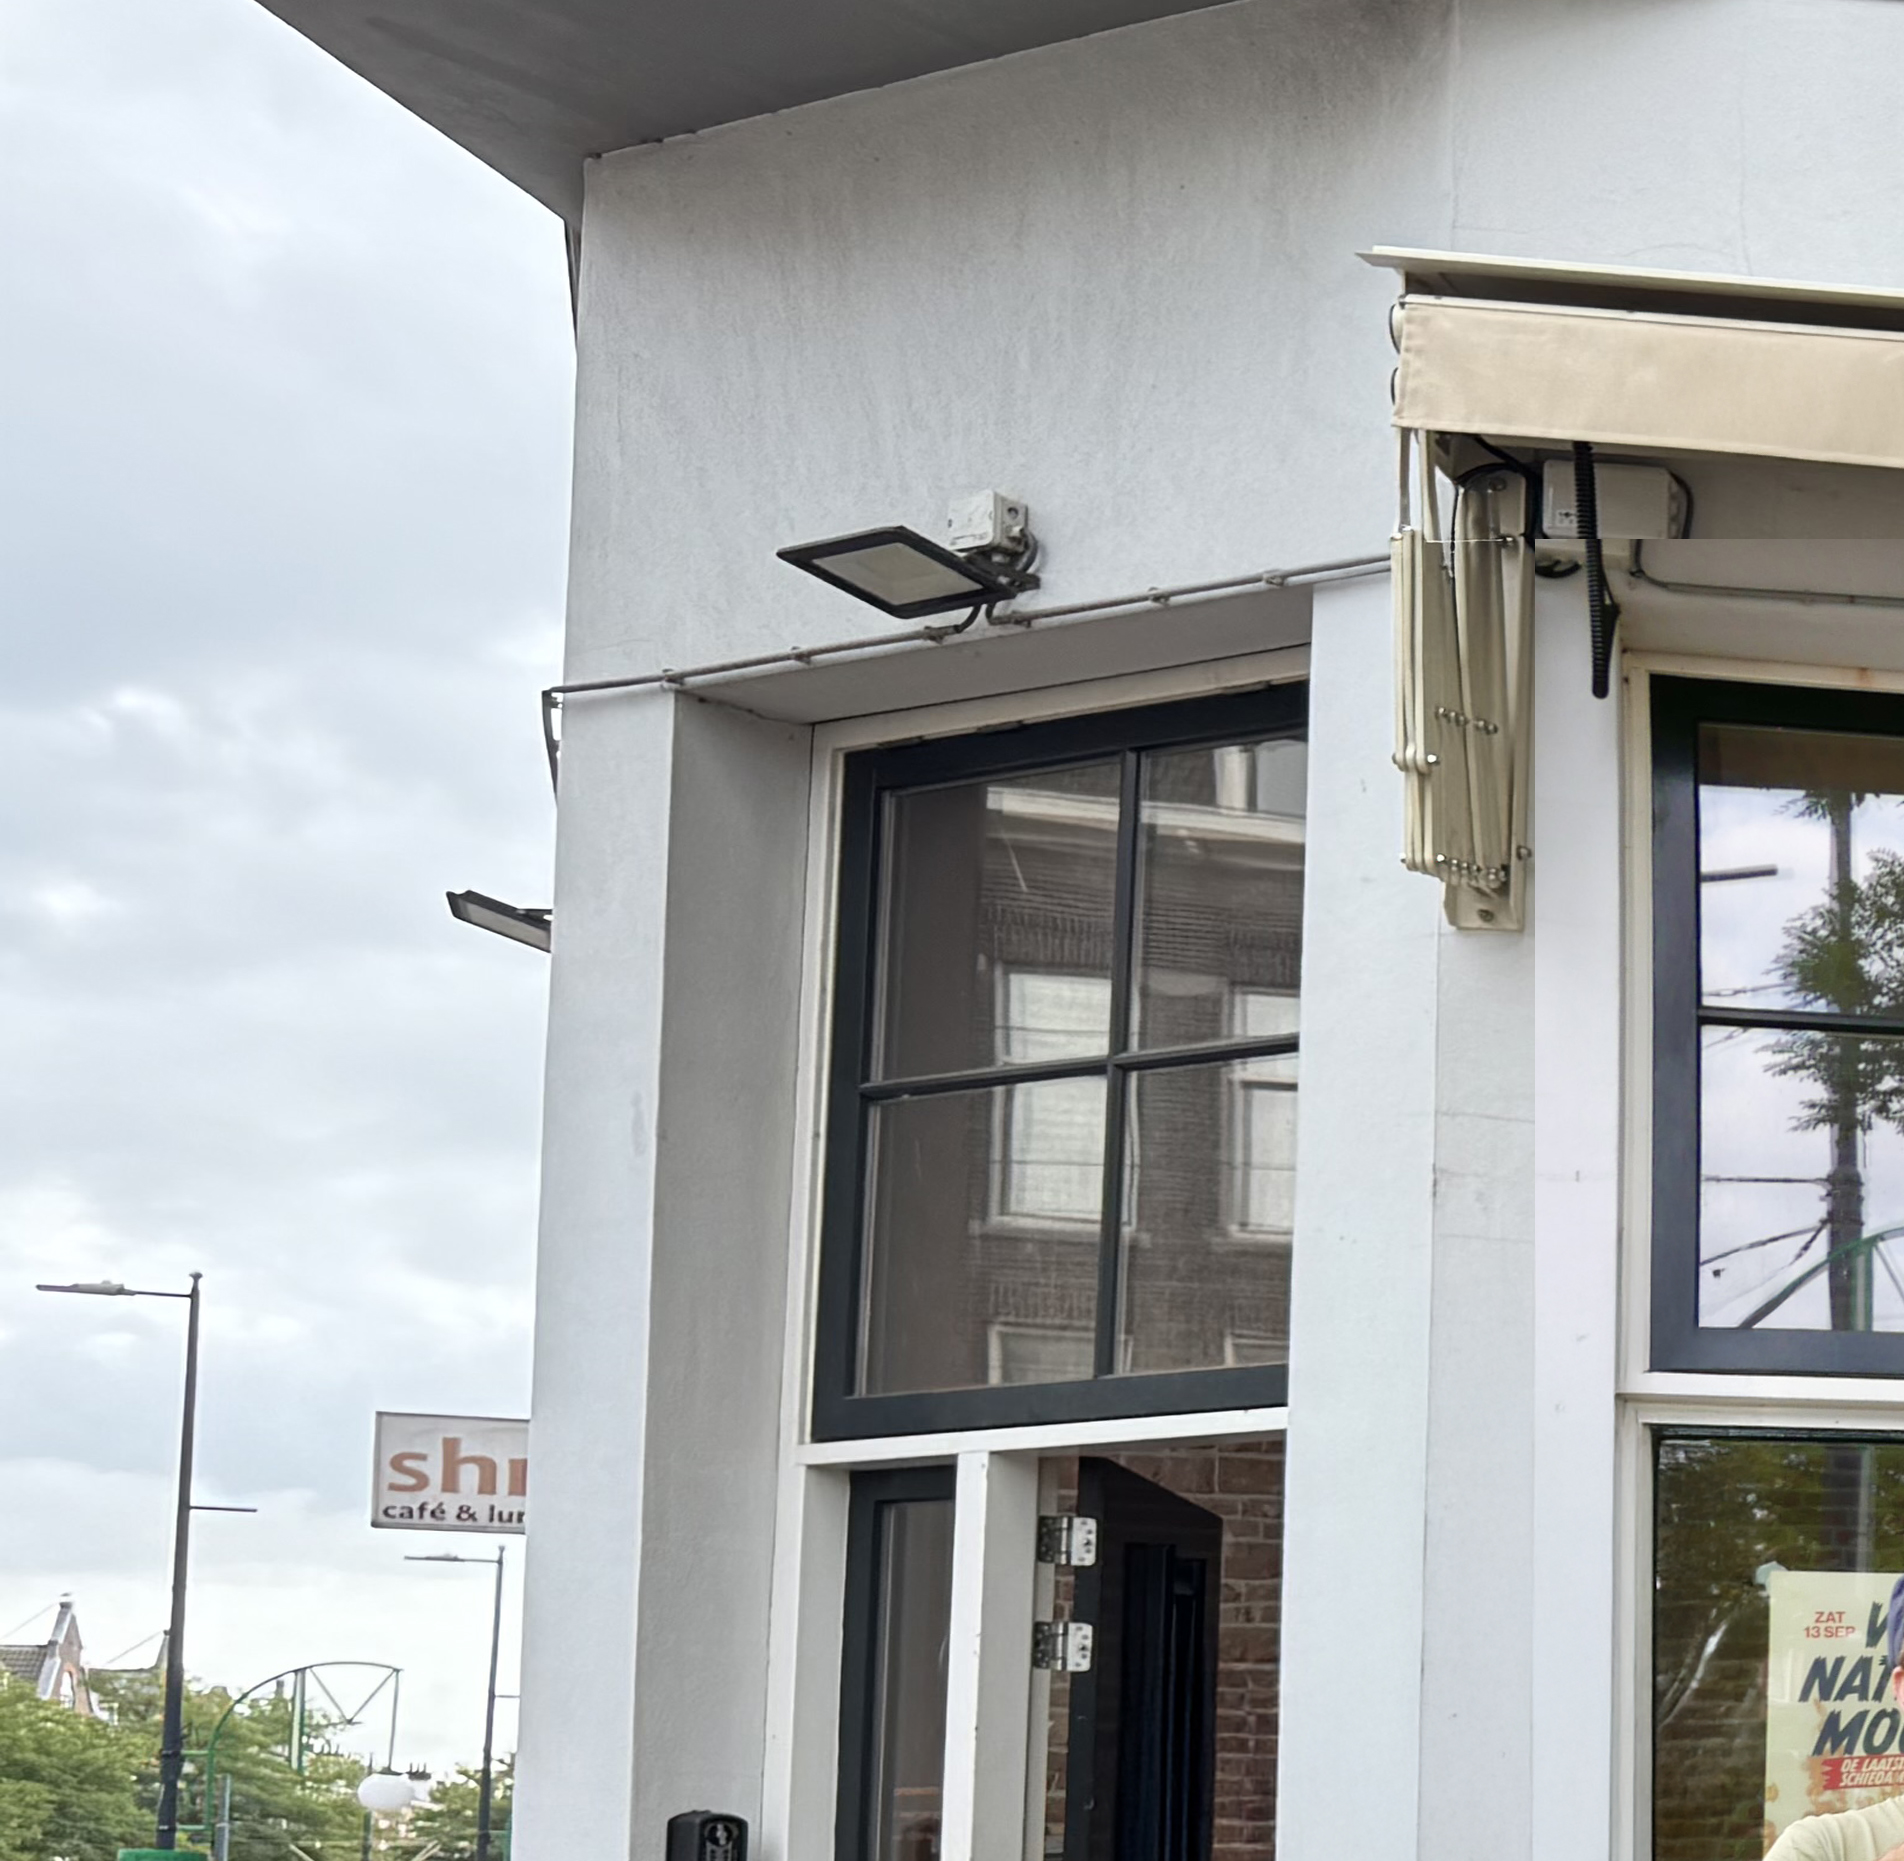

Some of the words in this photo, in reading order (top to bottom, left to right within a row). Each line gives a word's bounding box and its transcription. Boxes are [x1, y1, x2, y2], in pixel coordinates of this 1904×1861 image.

[382, 1501, 446, 1521] café
[456, 1504, 478, 1523] &
[1814, 1611, 1846, 1624] ZAT
[1804, 1626, 1821, 1639] 13
[1824, 1625, 1856, 1639] SEP
[1798, 1654, 1893, 1703] NAT
[1841, 1758, 1859, 1773] DE
